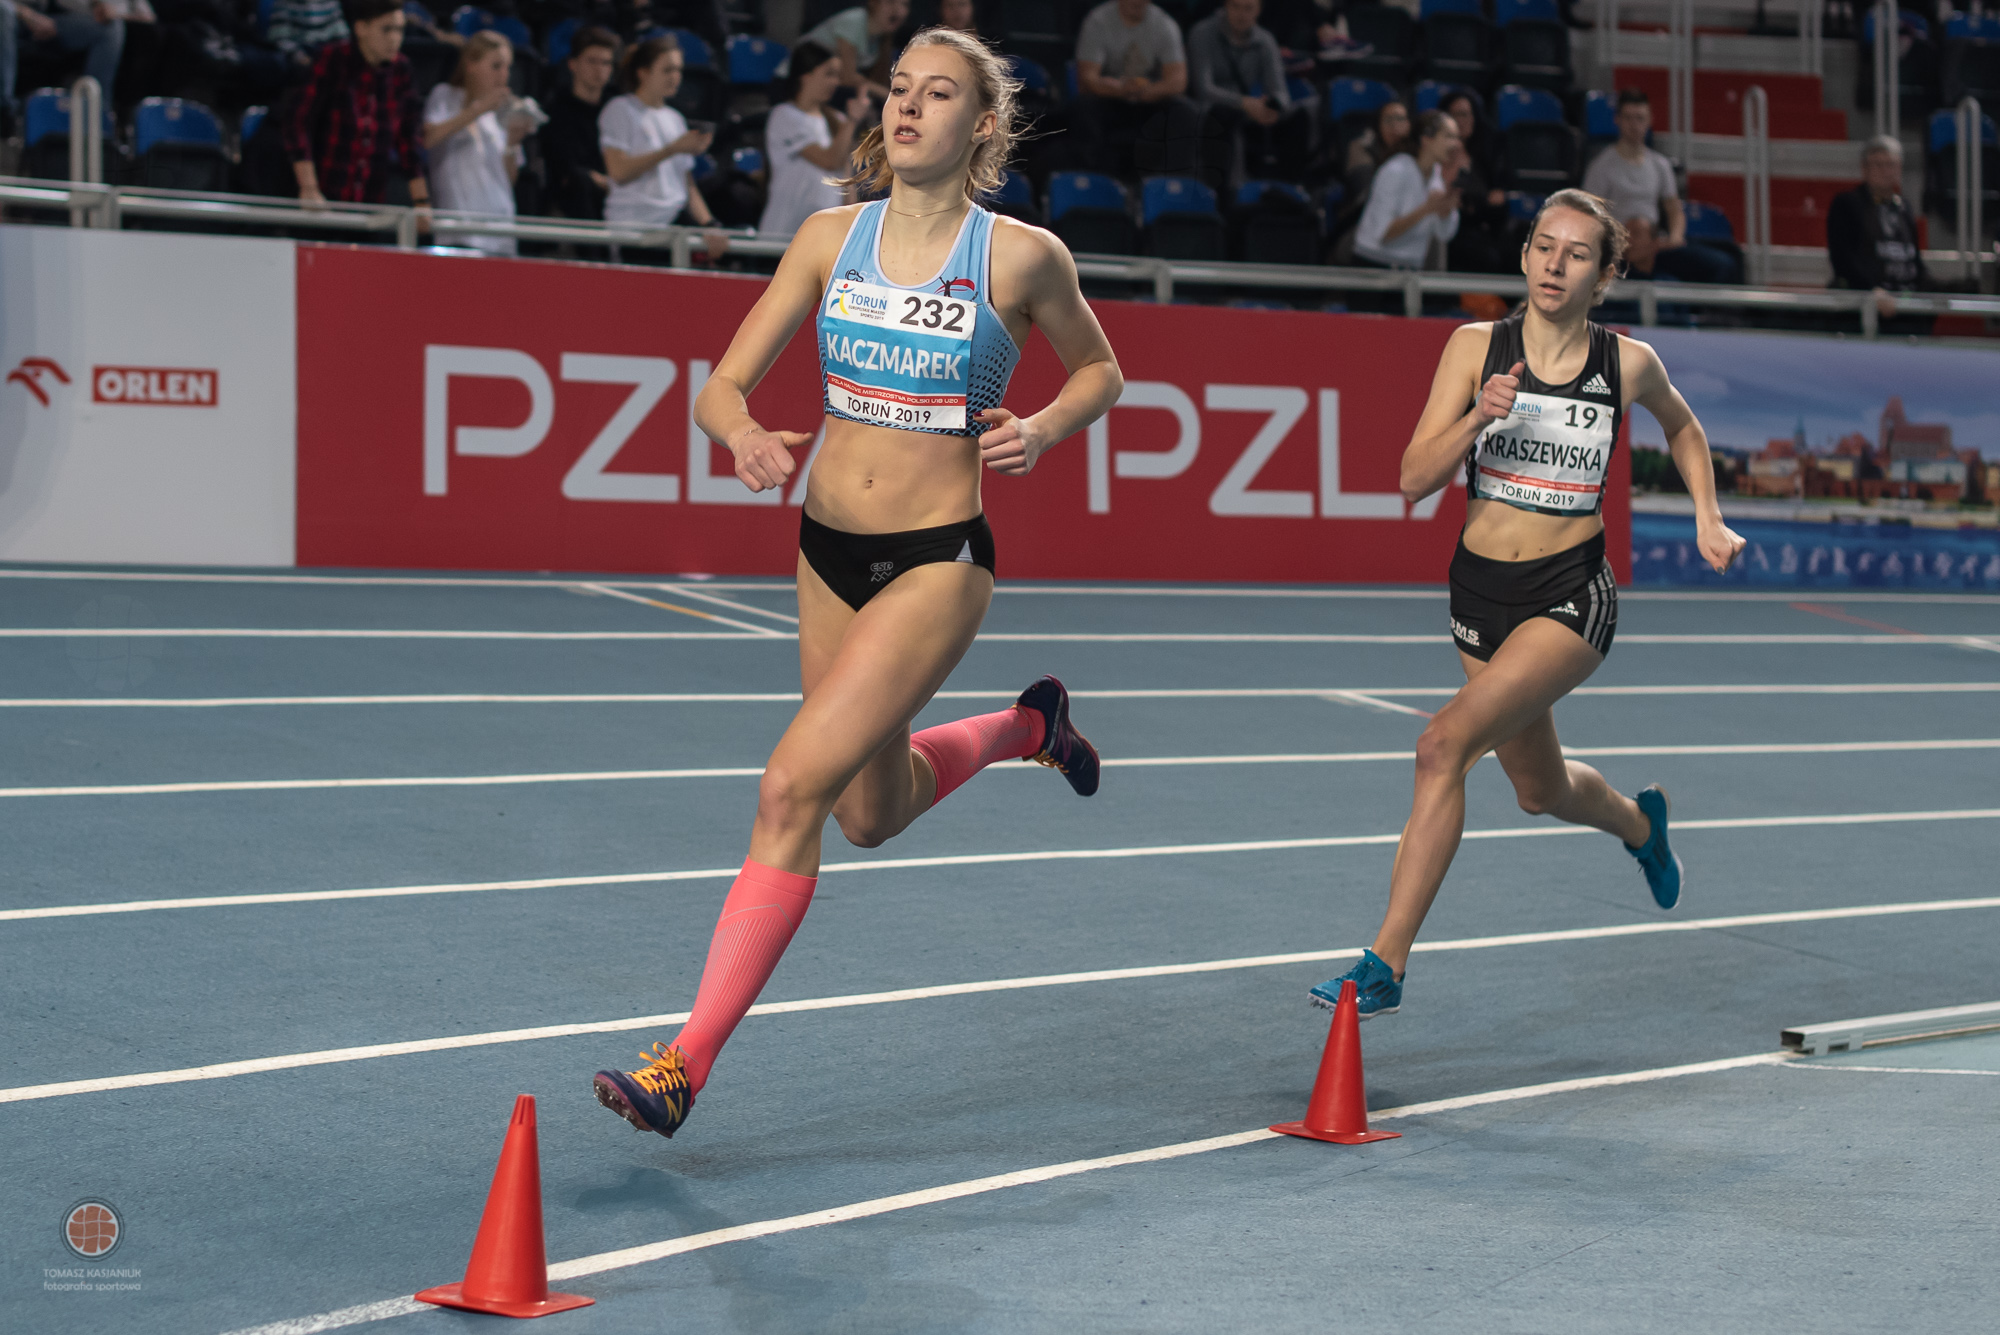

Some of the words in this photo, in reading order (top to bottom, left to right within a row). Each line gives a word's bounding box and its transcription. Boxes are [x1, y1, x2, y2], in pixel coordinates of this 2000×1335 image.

[851, 292, 888, 310] TORUŃ
[899, 295, 966, 333] 232
[826, 332, 963, 381] KACZMAREK
[98, 370, 211, 403] ORLEN
[862, 389, 907, 402] MISTRZOSTWA
[1582, 384, 1612, 395] adidas
[847, 396, 891, 419] TORUŃ
[894, 407, 932, 424] 2019
[1512, 401, 1542, 414] ORUŃ
[1565, 404, 1599, 429] 19
[1484, 432, 1601, 472] KRASZEWSKA
[1502, 482, 1541, 502] TORUŃ
[1544, 493, 1575, 506] 2019
